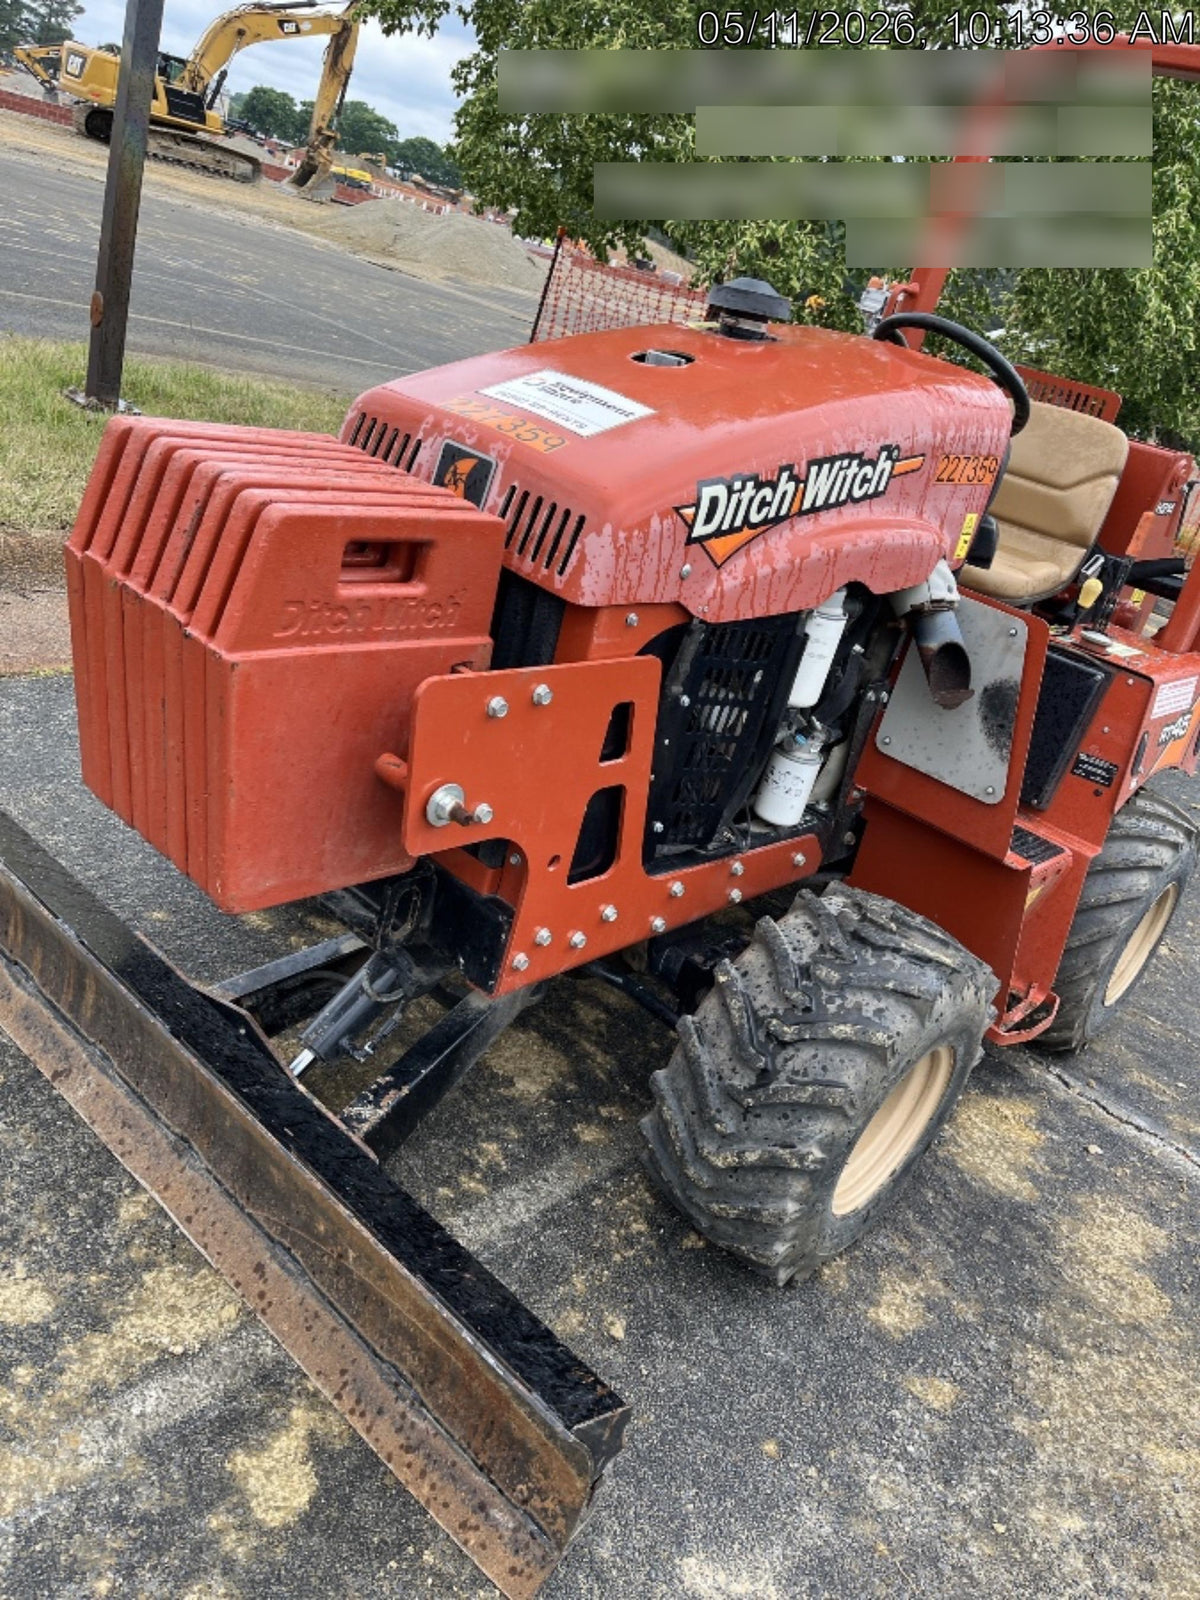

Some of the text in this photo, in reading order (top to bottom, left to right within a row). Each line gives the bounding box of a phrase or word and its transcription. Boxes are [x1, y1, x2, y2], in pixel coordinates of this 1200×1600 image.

[67, 53, 83, 75] CAT
[445, 398, 567, 452] 227359
[935, 454, 998, 483] 227359
[690, 450, 895, 538] Ditch Witch
[273, 599, 372, 637] Ditch
